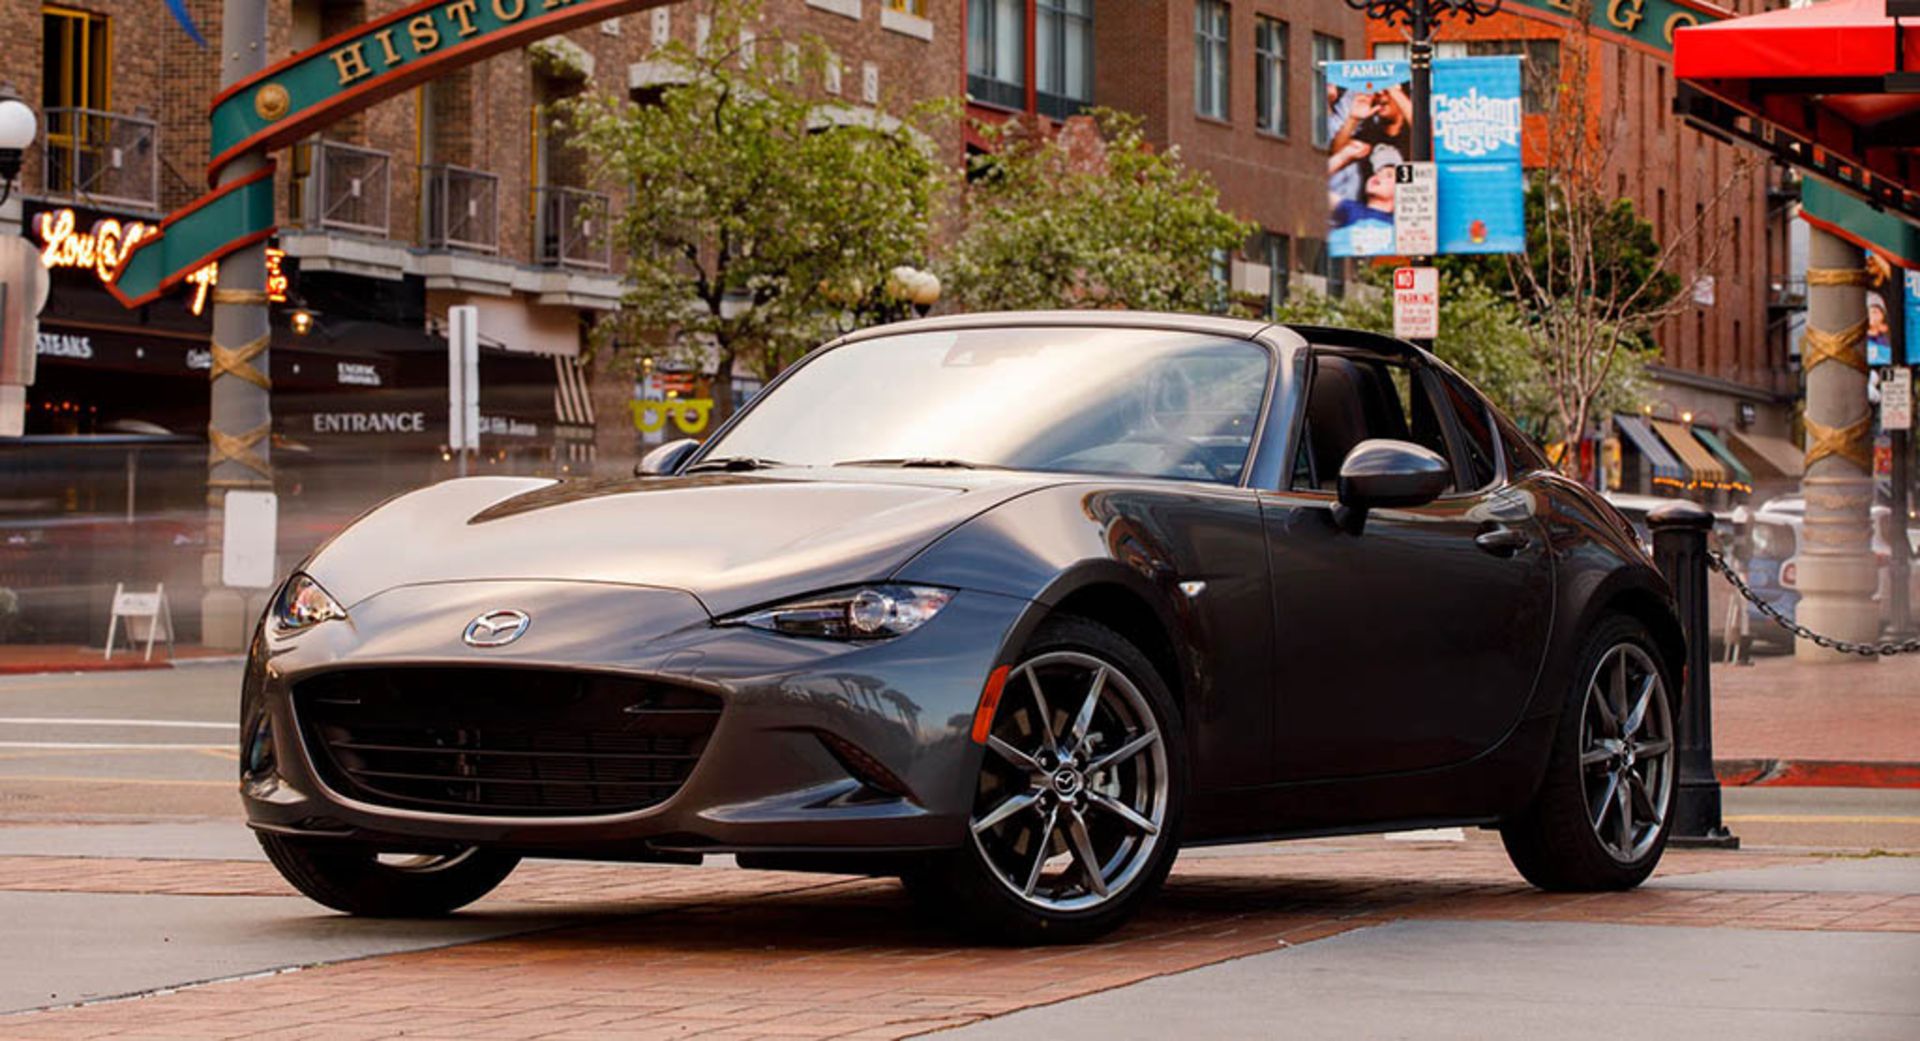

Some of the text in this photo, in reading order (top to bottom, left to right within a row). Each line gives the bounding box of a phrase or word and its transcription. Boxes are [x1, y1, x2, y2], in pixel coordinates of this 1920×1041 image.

[330, 0, 573, 85] HISTO
[1342, 64, 1395, 78] FAMILY
[41, 208, 96, 268] Lou
[36, 333, 93, 359] STEAKS
[313, 412, 425, 433] ENTRANCE
